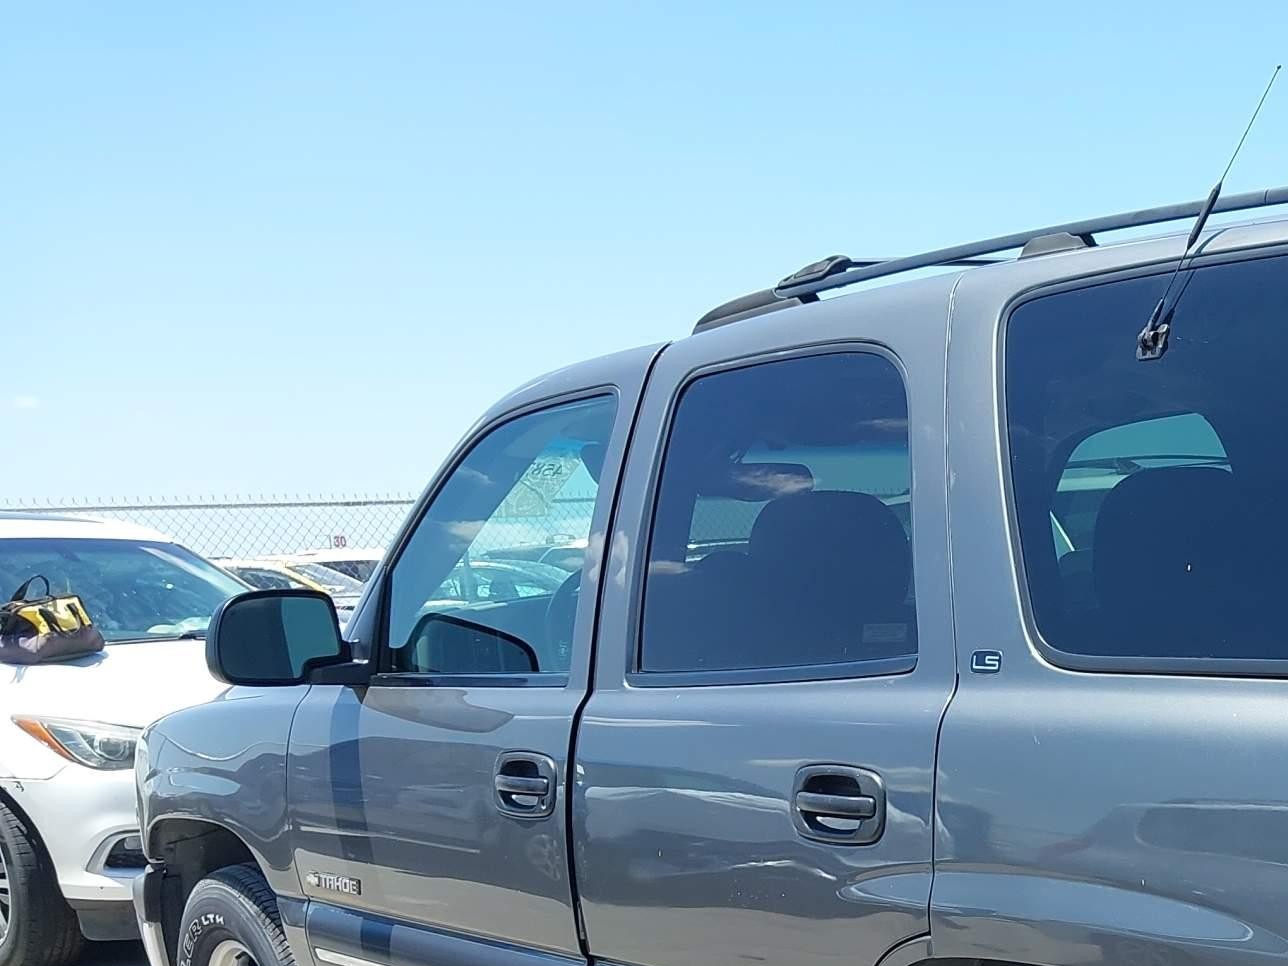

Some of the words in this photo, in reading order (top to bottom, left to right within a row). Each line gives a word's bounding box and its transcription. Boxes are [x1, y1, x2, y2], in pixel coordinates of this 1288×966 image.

[333, 535, 347, 548] 30
[972, 655, 1000, 670] LS
[320, 874, 357, 895] TAHOE
[201, 913, 225, 926] LTH
